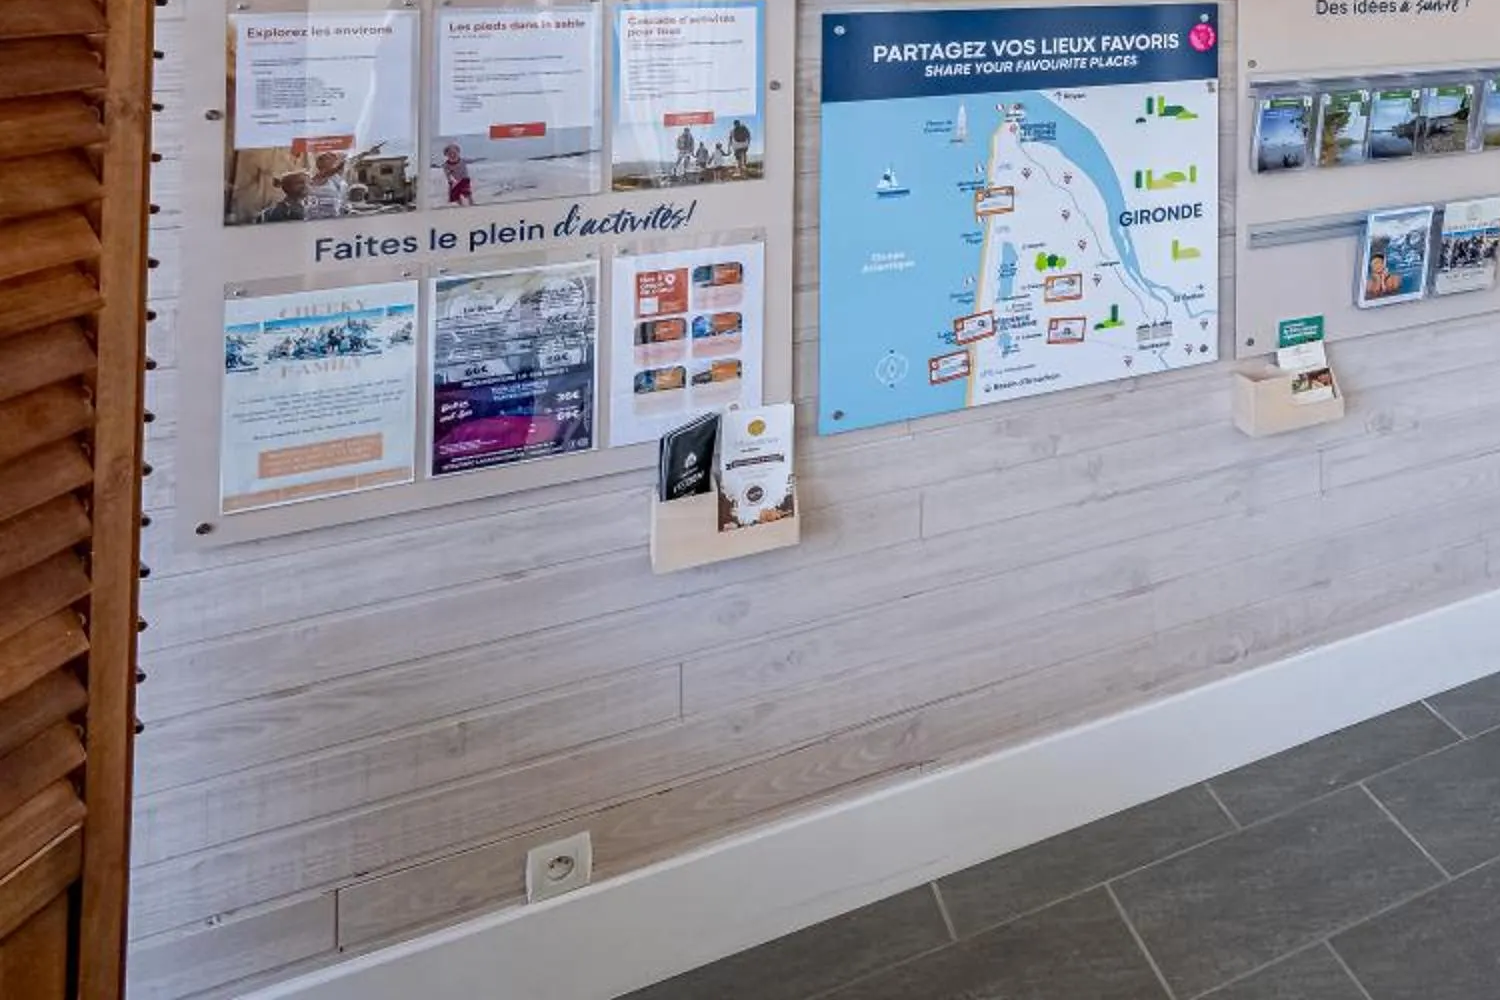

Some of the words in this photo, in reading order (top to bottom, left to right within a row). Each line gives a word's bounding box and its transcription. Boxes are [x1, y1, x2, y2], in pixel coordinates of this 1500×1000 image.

[1316, 0, 1348, 15] Des
[247, 27, 309, 39] Explorez
[335, 27, 393, 36] environs
[449, 21, 471, 32] Les
[473, 21, 508, 32] pieds
[873, 41, 987, 62] PARTAGEZ
[991, 39, 1035, 56] VOS
[1041, 37, 1097, 55] LIEUX
[1101, 33, 1180, 52] FAVORIS
[924, 62, 971, 77] SHARE
[975, 60, 1013, 74] YOUR
[1016, 57, 1086, 73] FAVOURITE
[1090, 55, 1140, 69] PLACES
[1118, 202, 1203, 229] GIRONDE
[315, 231, 418, 262] Faites
[429, 227, 457, 250] le
[469, 221, 544, 253] plein
